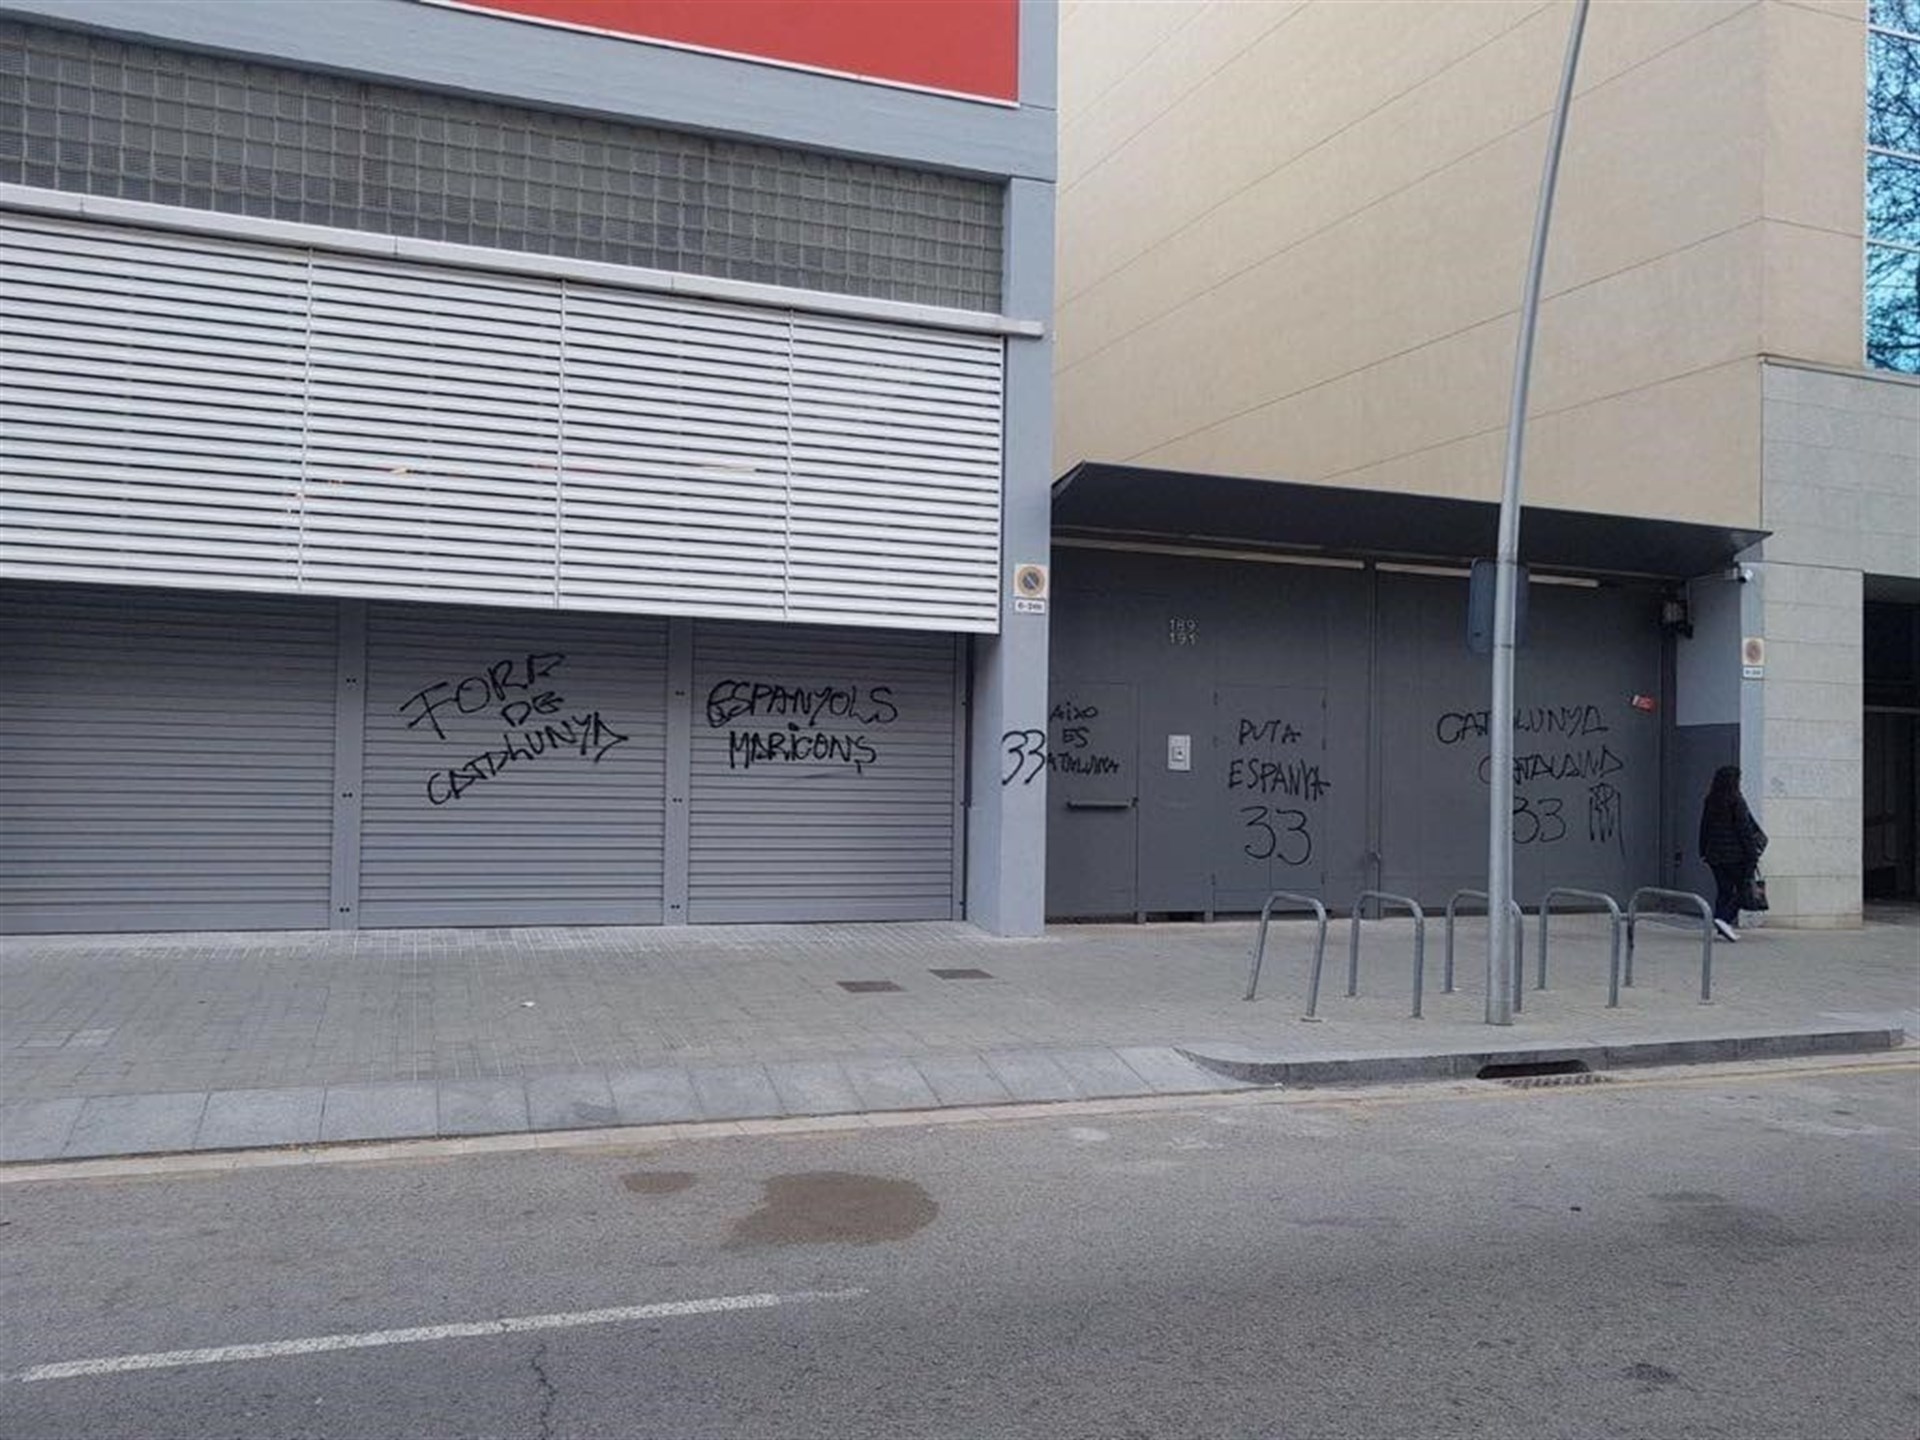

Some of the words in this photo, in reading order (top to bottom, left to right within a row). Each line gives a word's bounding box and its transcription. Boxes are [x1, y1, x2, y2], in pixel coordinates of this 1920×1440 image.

[501, 692, 564, 727] DE
[707, 679, 898, 728] ESPANYOLS
[1062, 726, 1090, 748] ES
[1239, 718, 1301, 745] PUTA
[1437, 705, 1608, 744] CATLUNYA
[1001, 729, 1046, 786] 33
[1228, 758, 1331, 801] ESPANYA
[1240, 805, 1311, 865] 33
